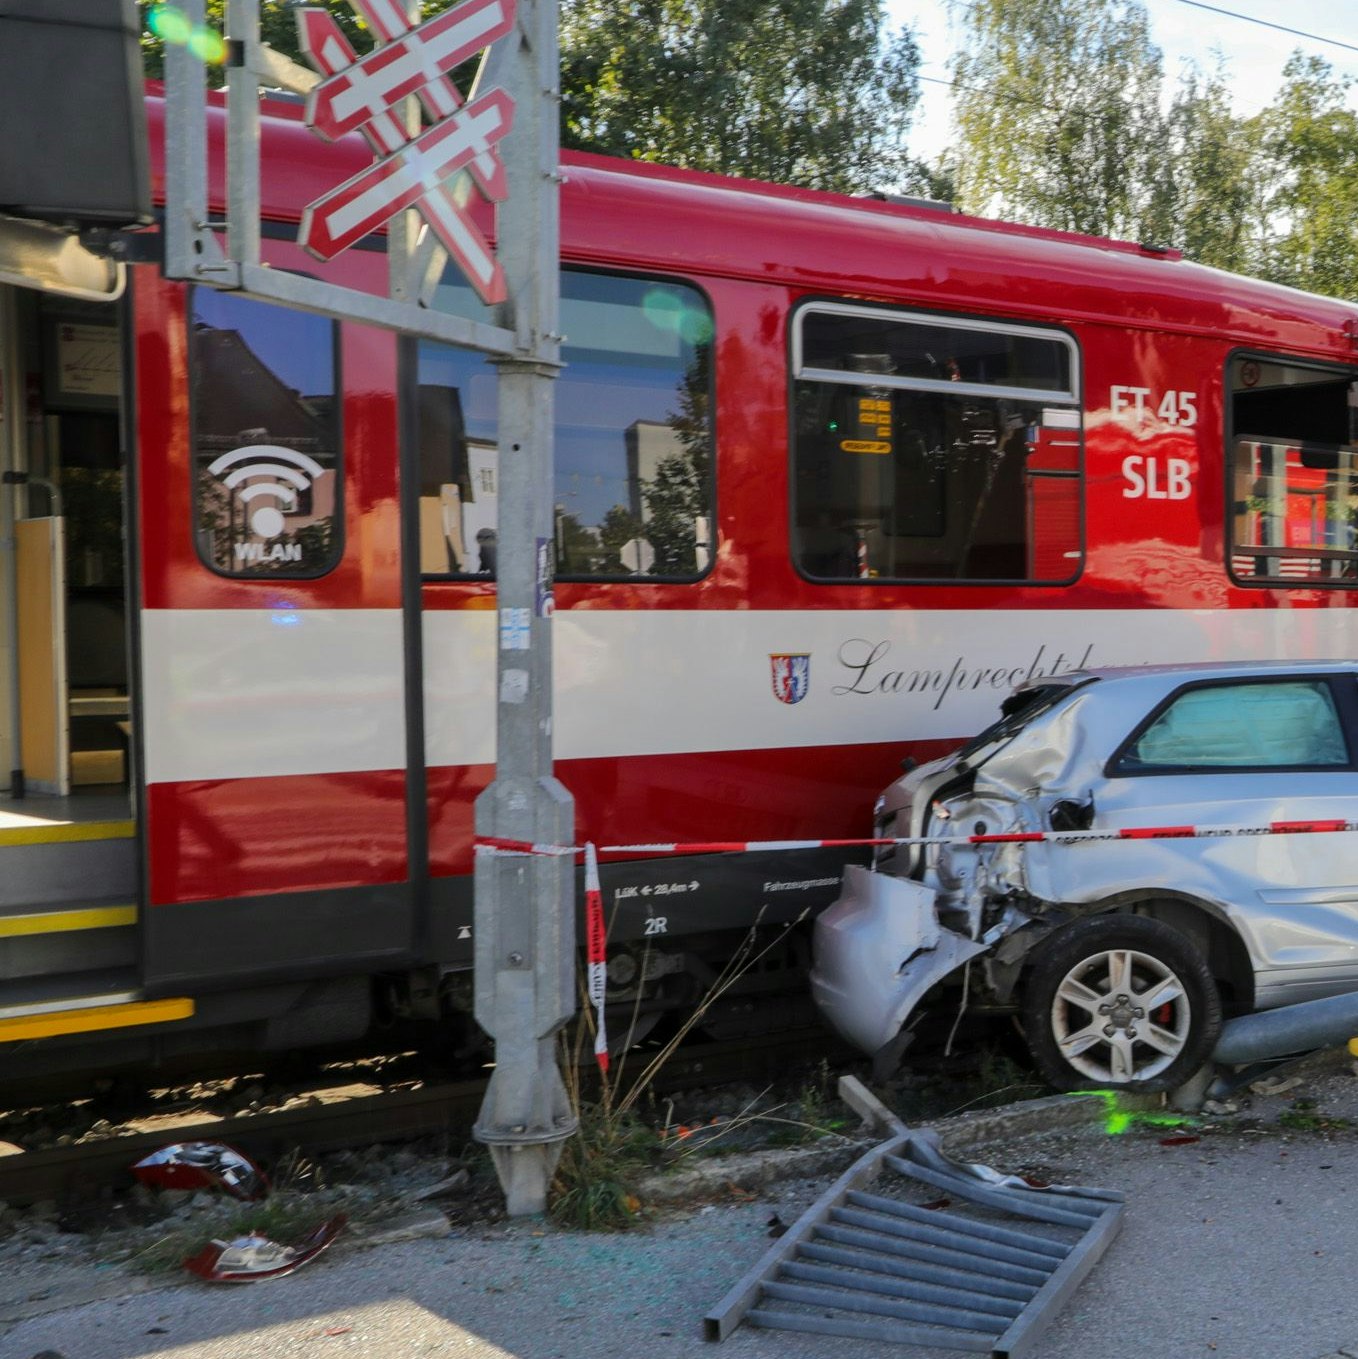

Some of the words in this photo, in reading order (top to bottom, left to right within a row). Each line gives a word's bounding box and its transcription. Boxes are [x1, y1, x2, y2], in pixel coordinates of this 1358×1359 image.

[1110, 385, 1151, 422] ET
[1157, 390, 1198, 426] 45
[1121, 455, 1192, 500] SLB
[234, 543, 302, 562] WLAN
[644, 917, 668, 936] 2R
